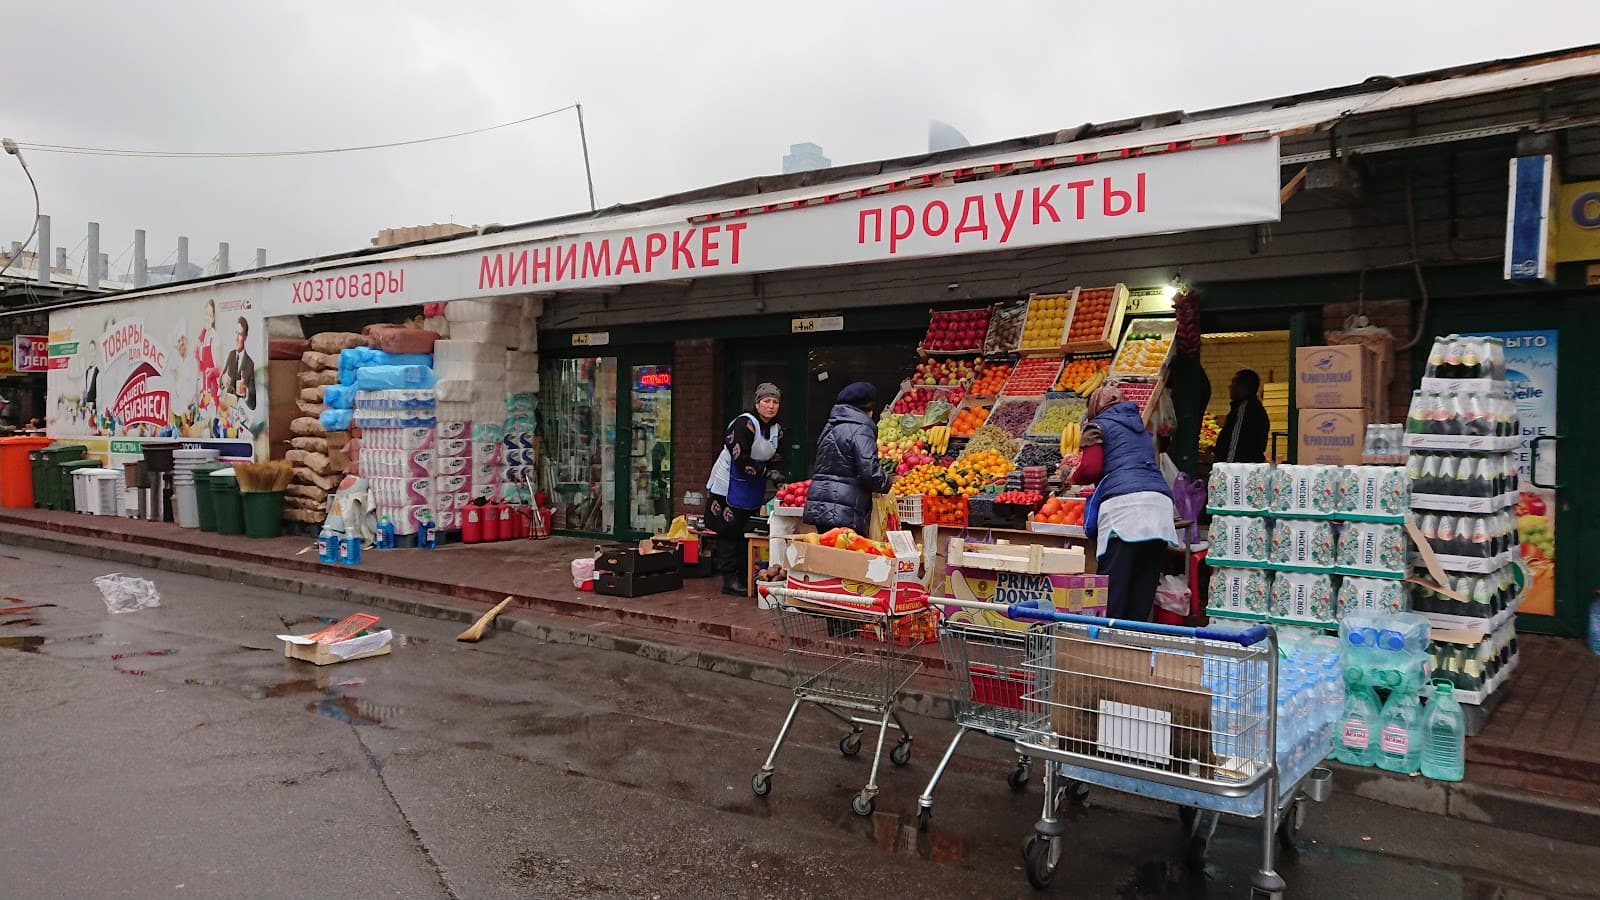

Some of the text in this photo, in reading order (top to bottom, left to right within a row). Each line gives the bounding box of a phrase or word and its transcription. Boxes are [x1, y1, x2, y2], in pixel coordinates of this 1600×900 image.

[858, 172, 1147, 254] продукты
[478, 222, 748, 290] МИНИМАРКЕТ
[292, 268, 404, 304] хозтовары
[102, 323, 143, 363] ТОВАРЫ
[143, 339, 166, 368] ВАС
[124, 395, 167, 423] БИЗНЕСА
[1233, 475, 1241, 505] BORJOMI
[1365, 477, 1374, 509] BORJOMI
[1233, 525, 1241, 555] BORJOMI
[1298, 530, 1306, 561] BORJOMI
[1365, 532, 1374, 564] BORJOMI
[898, 560, 915, 572] Dole
[997, 573, 1054, 593] PRIMA
[1232, 576, 1240, 607] BORJOMI
[1297, 584, 1305, 615] BORJOMI
